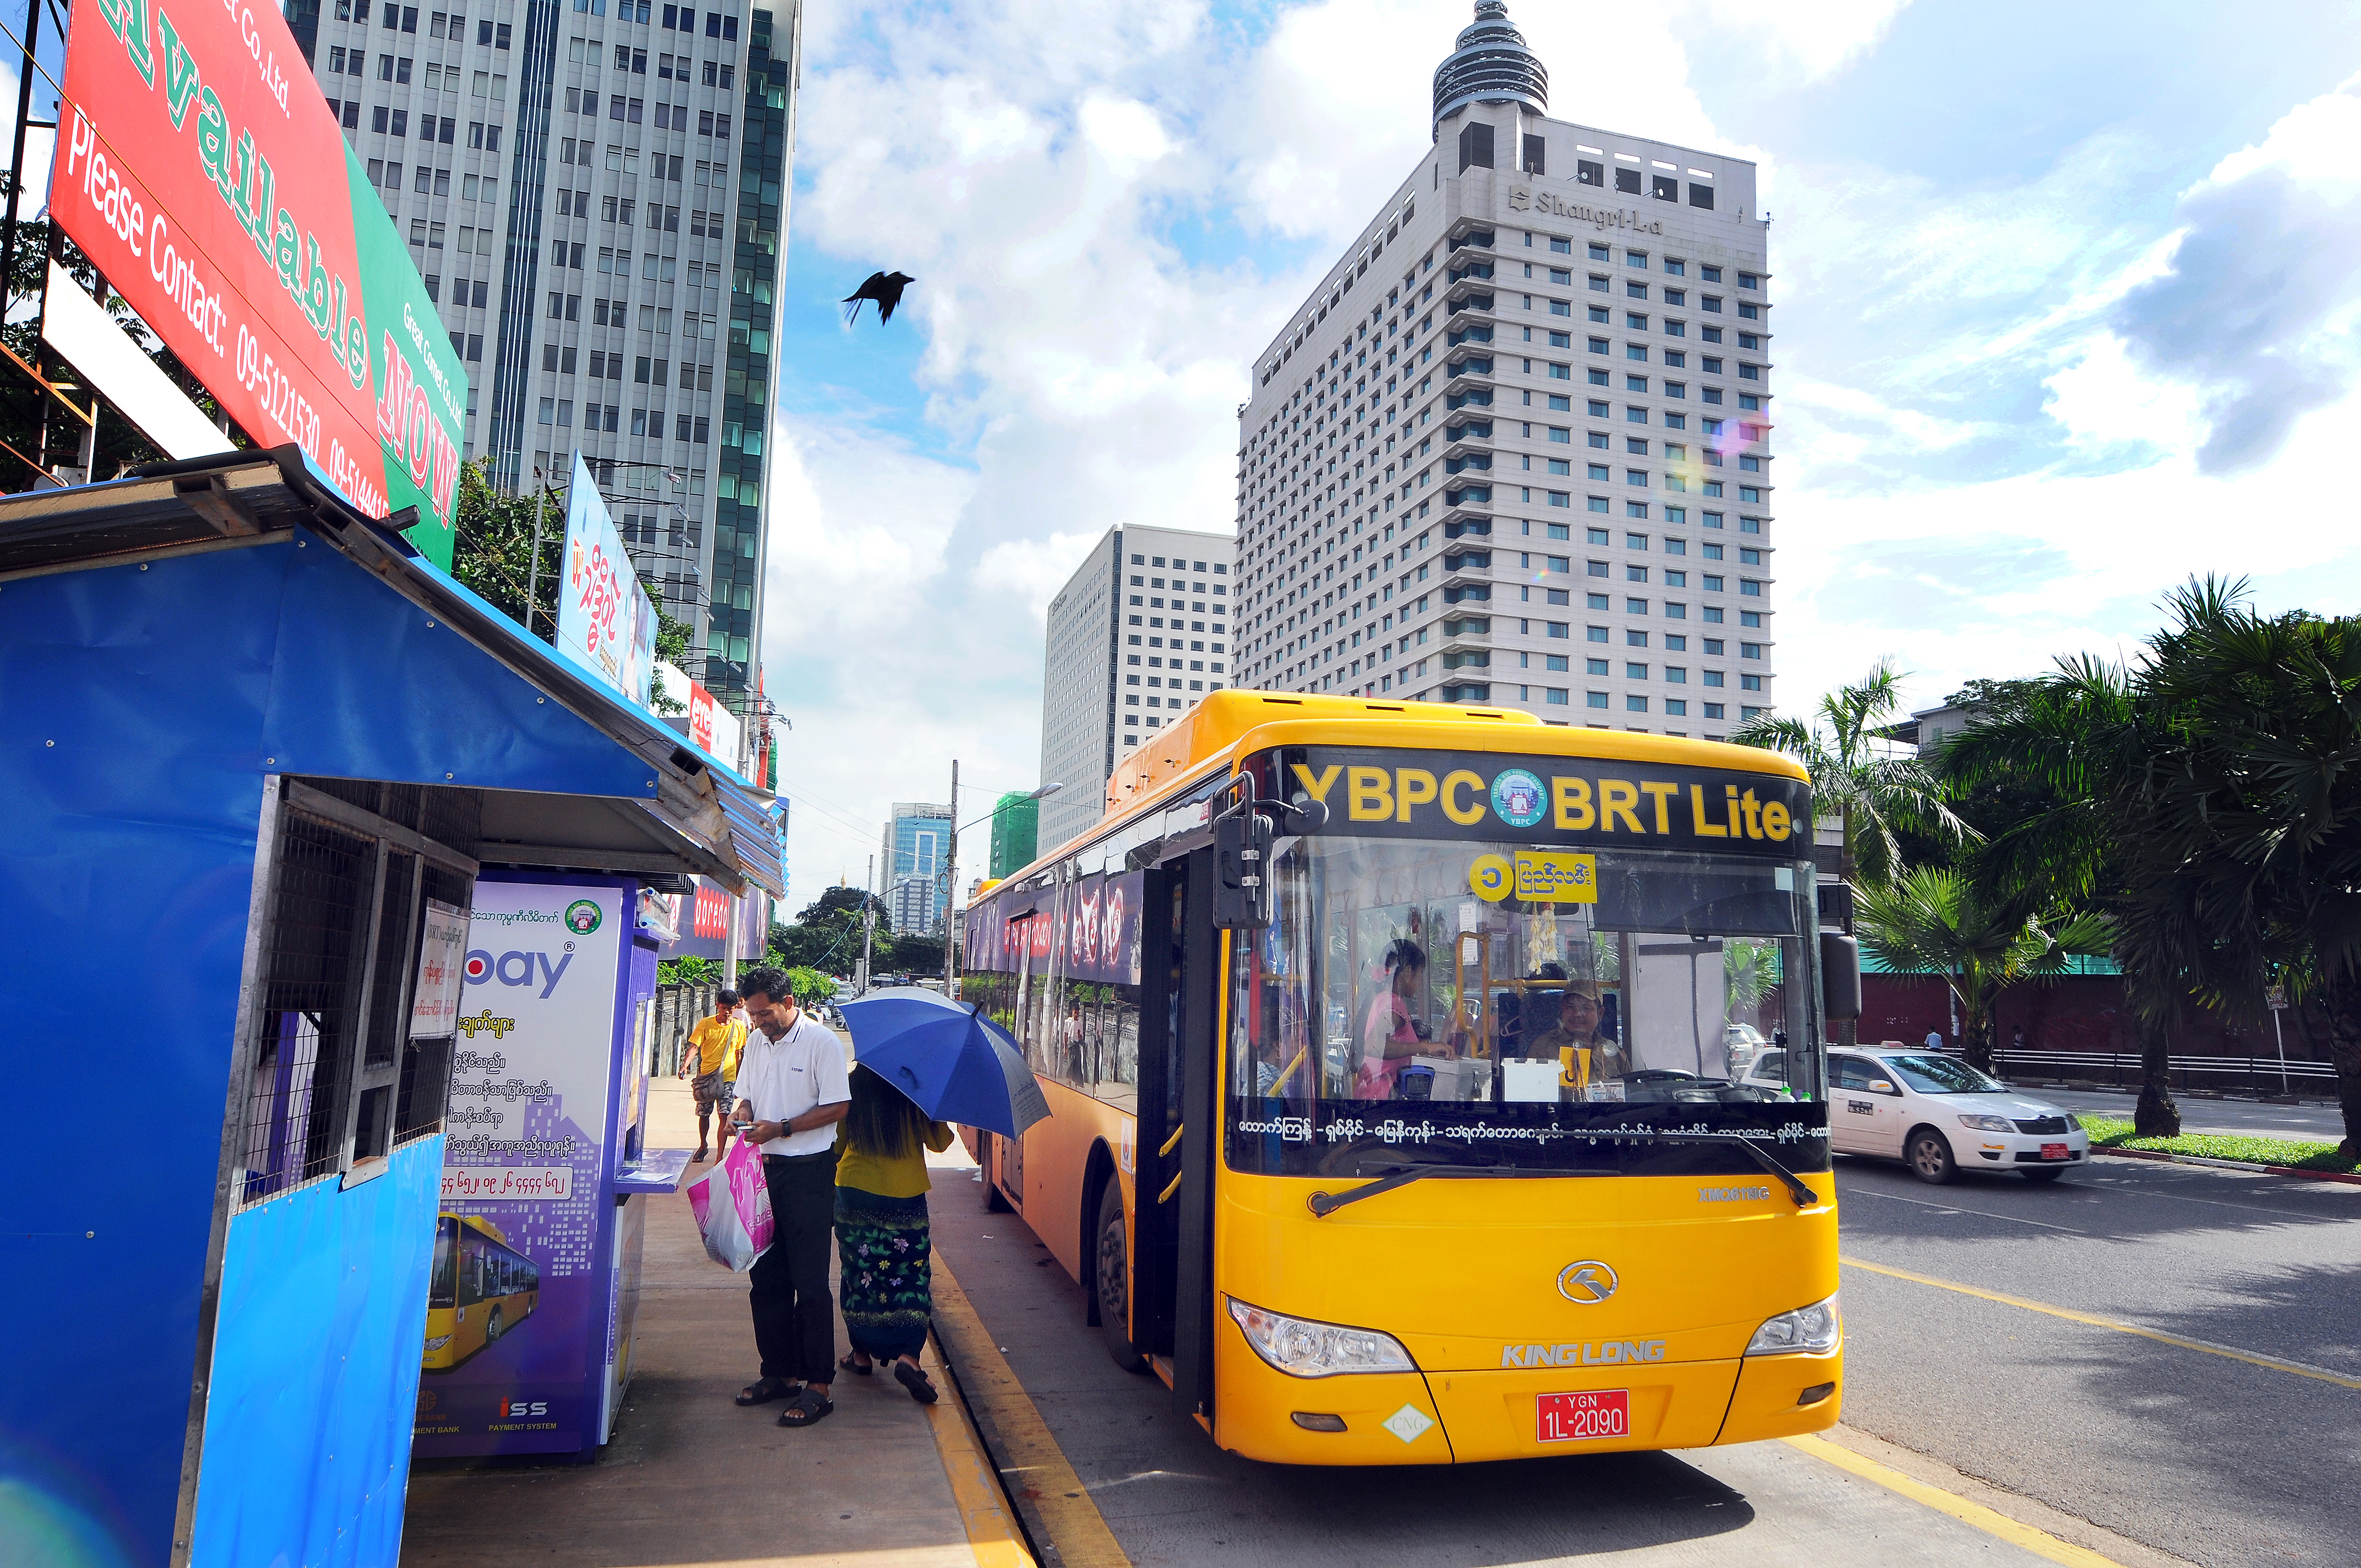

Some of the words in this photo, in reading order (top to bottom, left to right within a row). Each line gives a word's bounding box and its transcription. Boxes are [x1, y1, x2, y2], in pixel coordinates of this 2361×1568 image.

[241, 7, 291, 119] Co.,Ltd.
[1535, 190, 1663, 235] Shangri-La
[68, 102, 144, 257] Please
[150, 213, 227, 358] Contact:
[236, 323, 320, 462] 09-5121530
[403, 302, 423, 358] Great
[423, 339, 444, 394] Comet
[443, 378, 463, 431] Co.,Ltd.
[376, 328, 459, 531] NOW
[1290, 764, 1487, 826] YBPC
[1552, 776, 1679, 835] BRT
[1690, 783, 1791, 842] Lite
[1517, 860, 1591, 894] ပြည်လမ်း
[695, 893, 728, 930] ooredo
[1697, 1186, 1770, 1202] XMQ6119G
[1501, 1343, 1578, 1367] KING
[1582, 1340, 1666, 1364] LONG
[1568, 1395, 1597, 1409] YGN
[1392, 1415, 1423, 1431] CNG
[1546, 1408, 1623, 1438] 1L-2090
